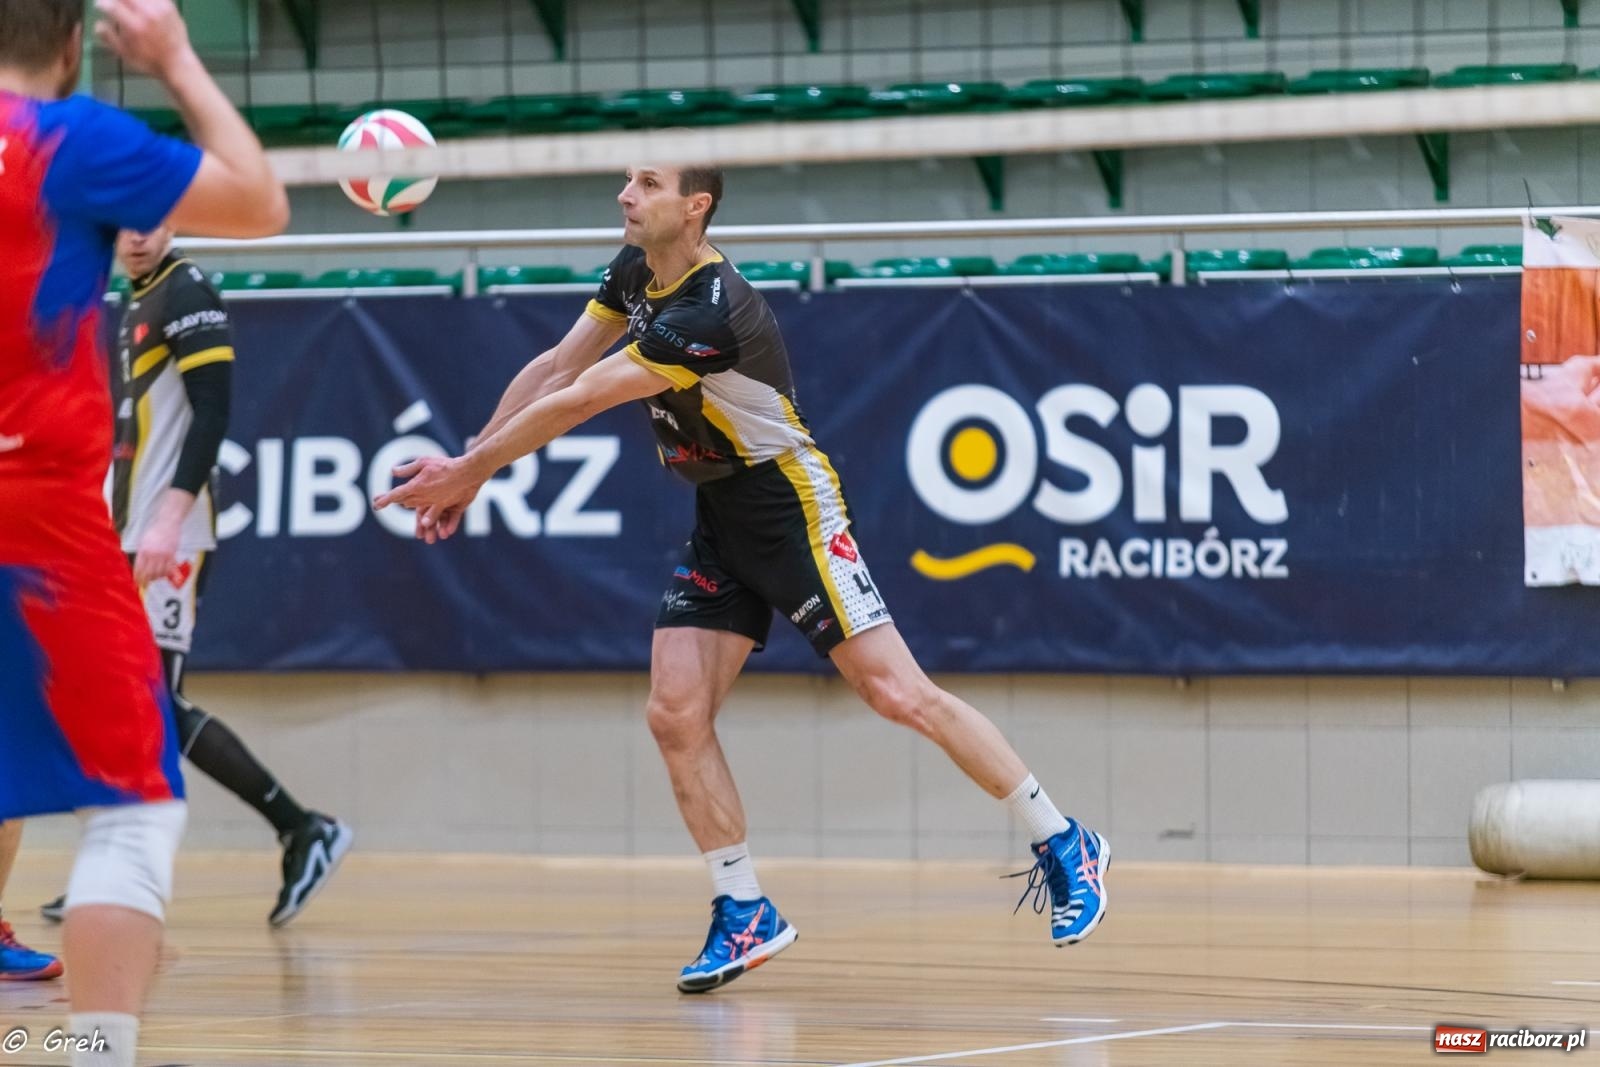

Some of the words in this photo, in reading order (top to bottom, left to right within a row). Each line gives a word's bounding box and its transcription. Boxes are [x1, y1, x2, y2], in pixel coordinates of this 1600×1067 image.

[906, 382, 1289, 525] OSiR
[1059, 525, 1289, 579] RACIBÓRZ
[853, 570, 882, 605] 4
[163, 598, 182, 630] 3
